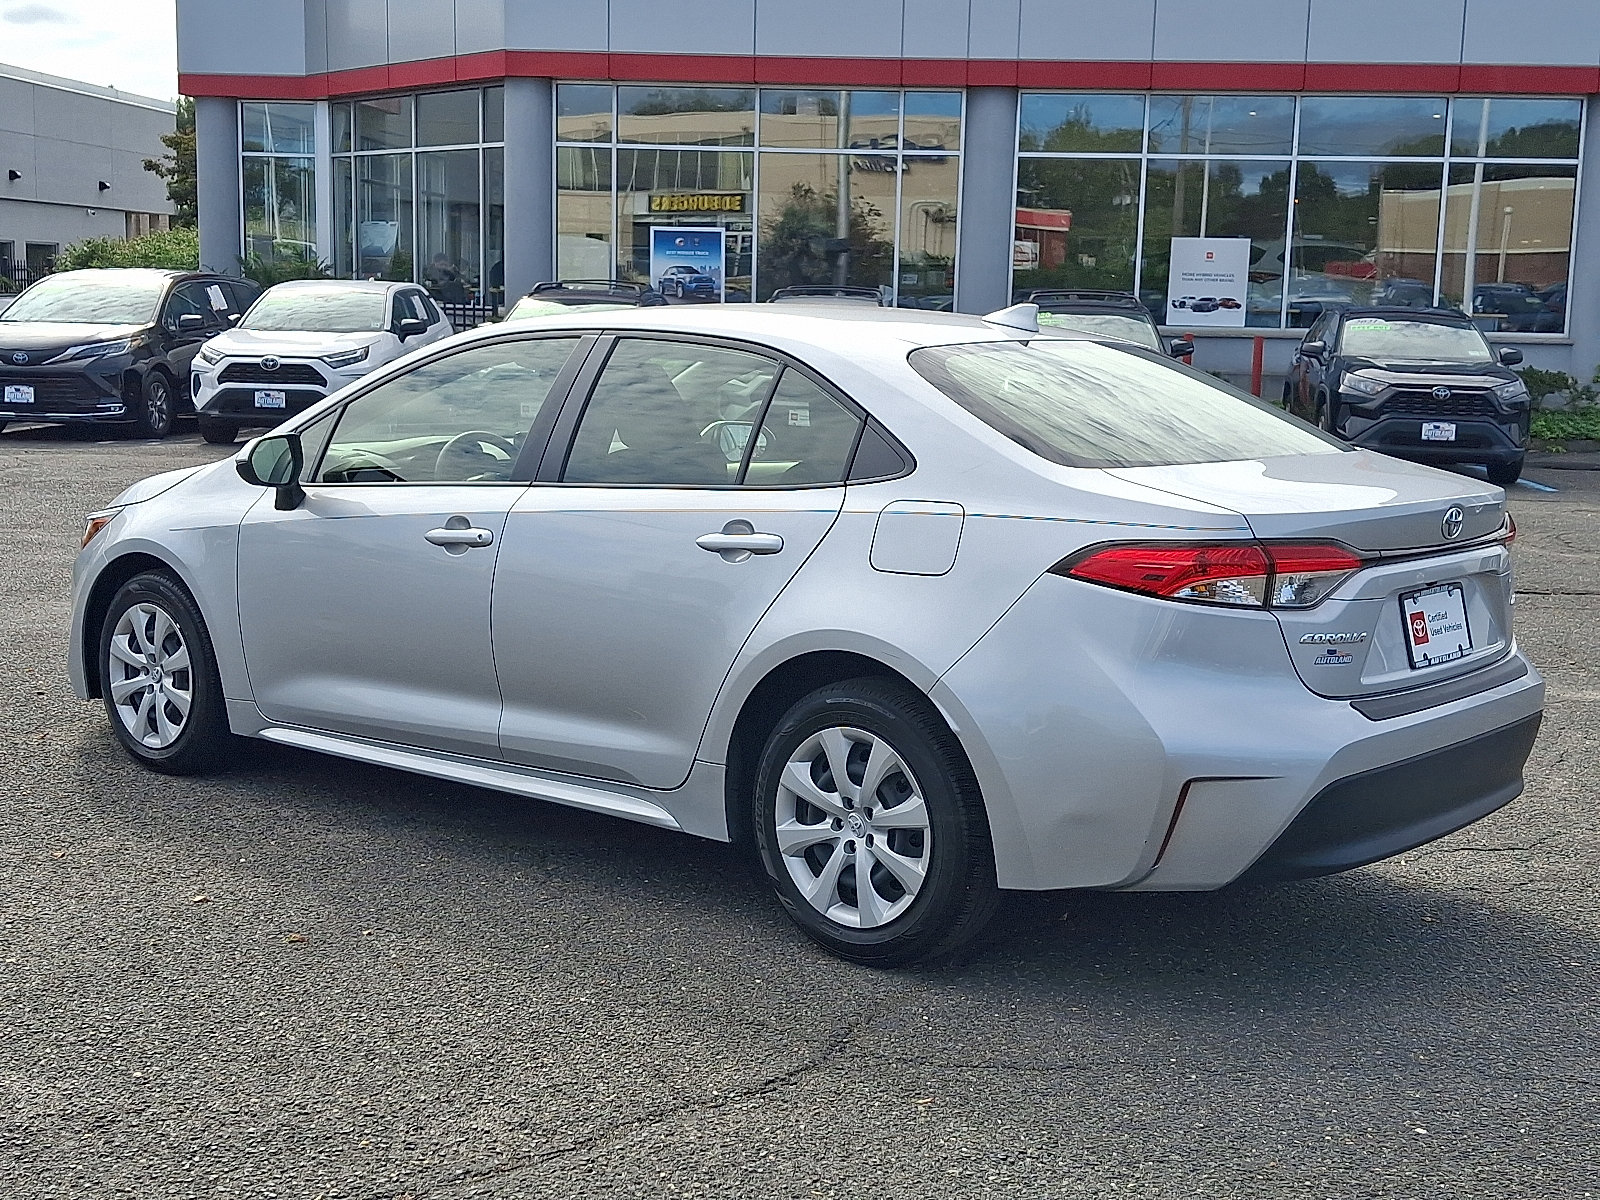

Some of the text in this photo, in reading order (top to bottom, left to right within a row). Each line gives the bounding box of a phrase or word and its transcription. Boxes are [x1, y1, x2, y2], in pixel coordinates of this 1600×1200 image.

[1428, 611, 1448, 623] Certified
[1430, 622, 1463, 637] Used Vehicles
[1300, 631, 1367, 645] COROLLA
[1315, 656, 1353, 664] AUTOLAND
[1430, 651, 1462, 665] AUTOLAND
